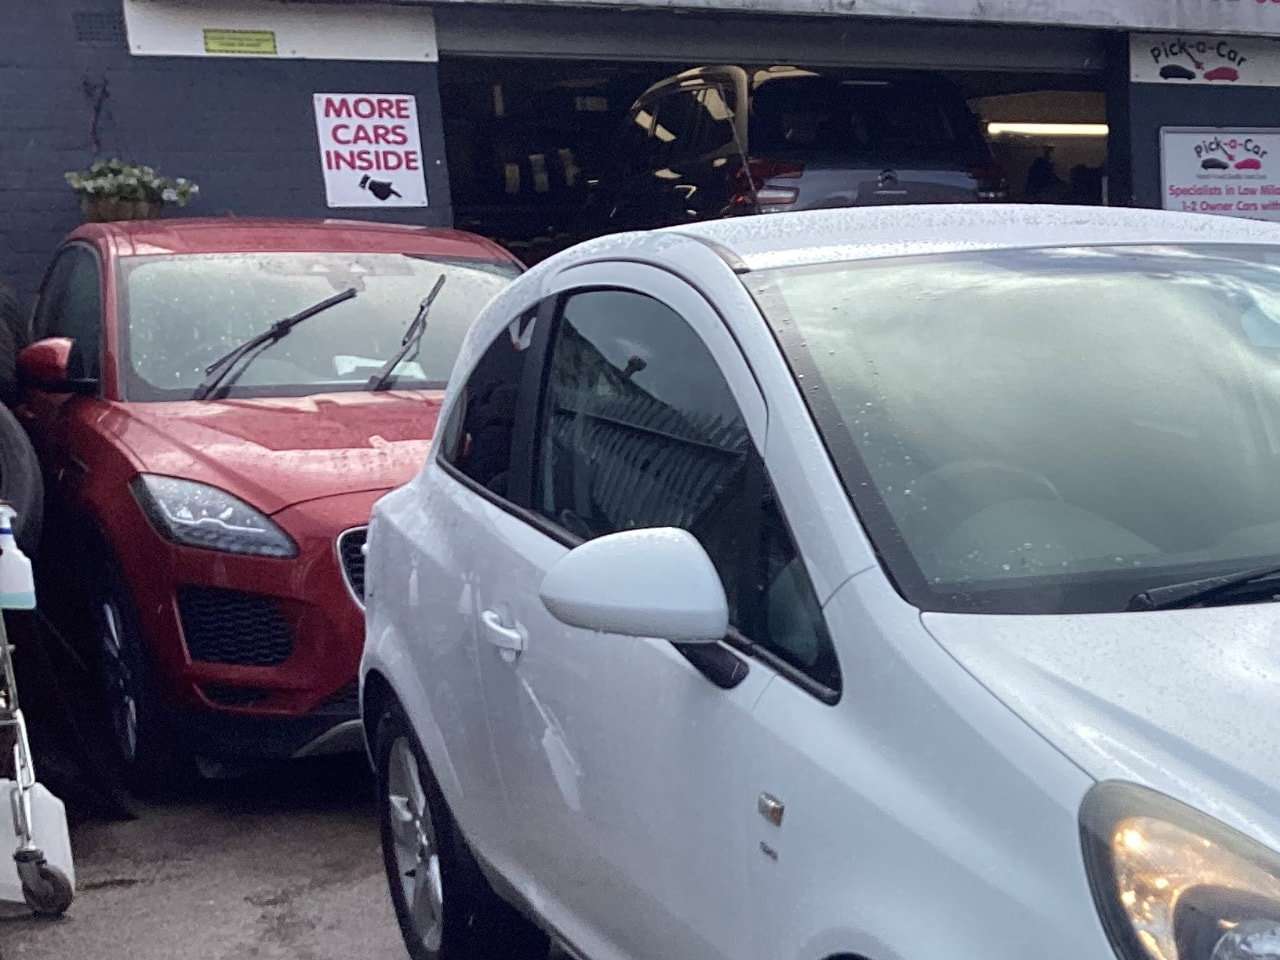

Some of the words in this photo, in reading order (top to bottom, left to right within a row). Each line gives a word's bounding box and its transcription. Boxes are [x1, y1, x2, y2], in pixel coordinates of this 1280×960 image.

[324, 96, 411, 119] MORE
[331, 123, 408, 145] CARS
[325, 149, 419, 171] INSIDE
[1168, 185, 1222, 197] Specialists
[1225, 185, 1235, 195] in
[1238, 185, 1257, 195] Low
[1199, 201, 1234, 211] Owner
[1236, 201, 1259, 212] Cars
